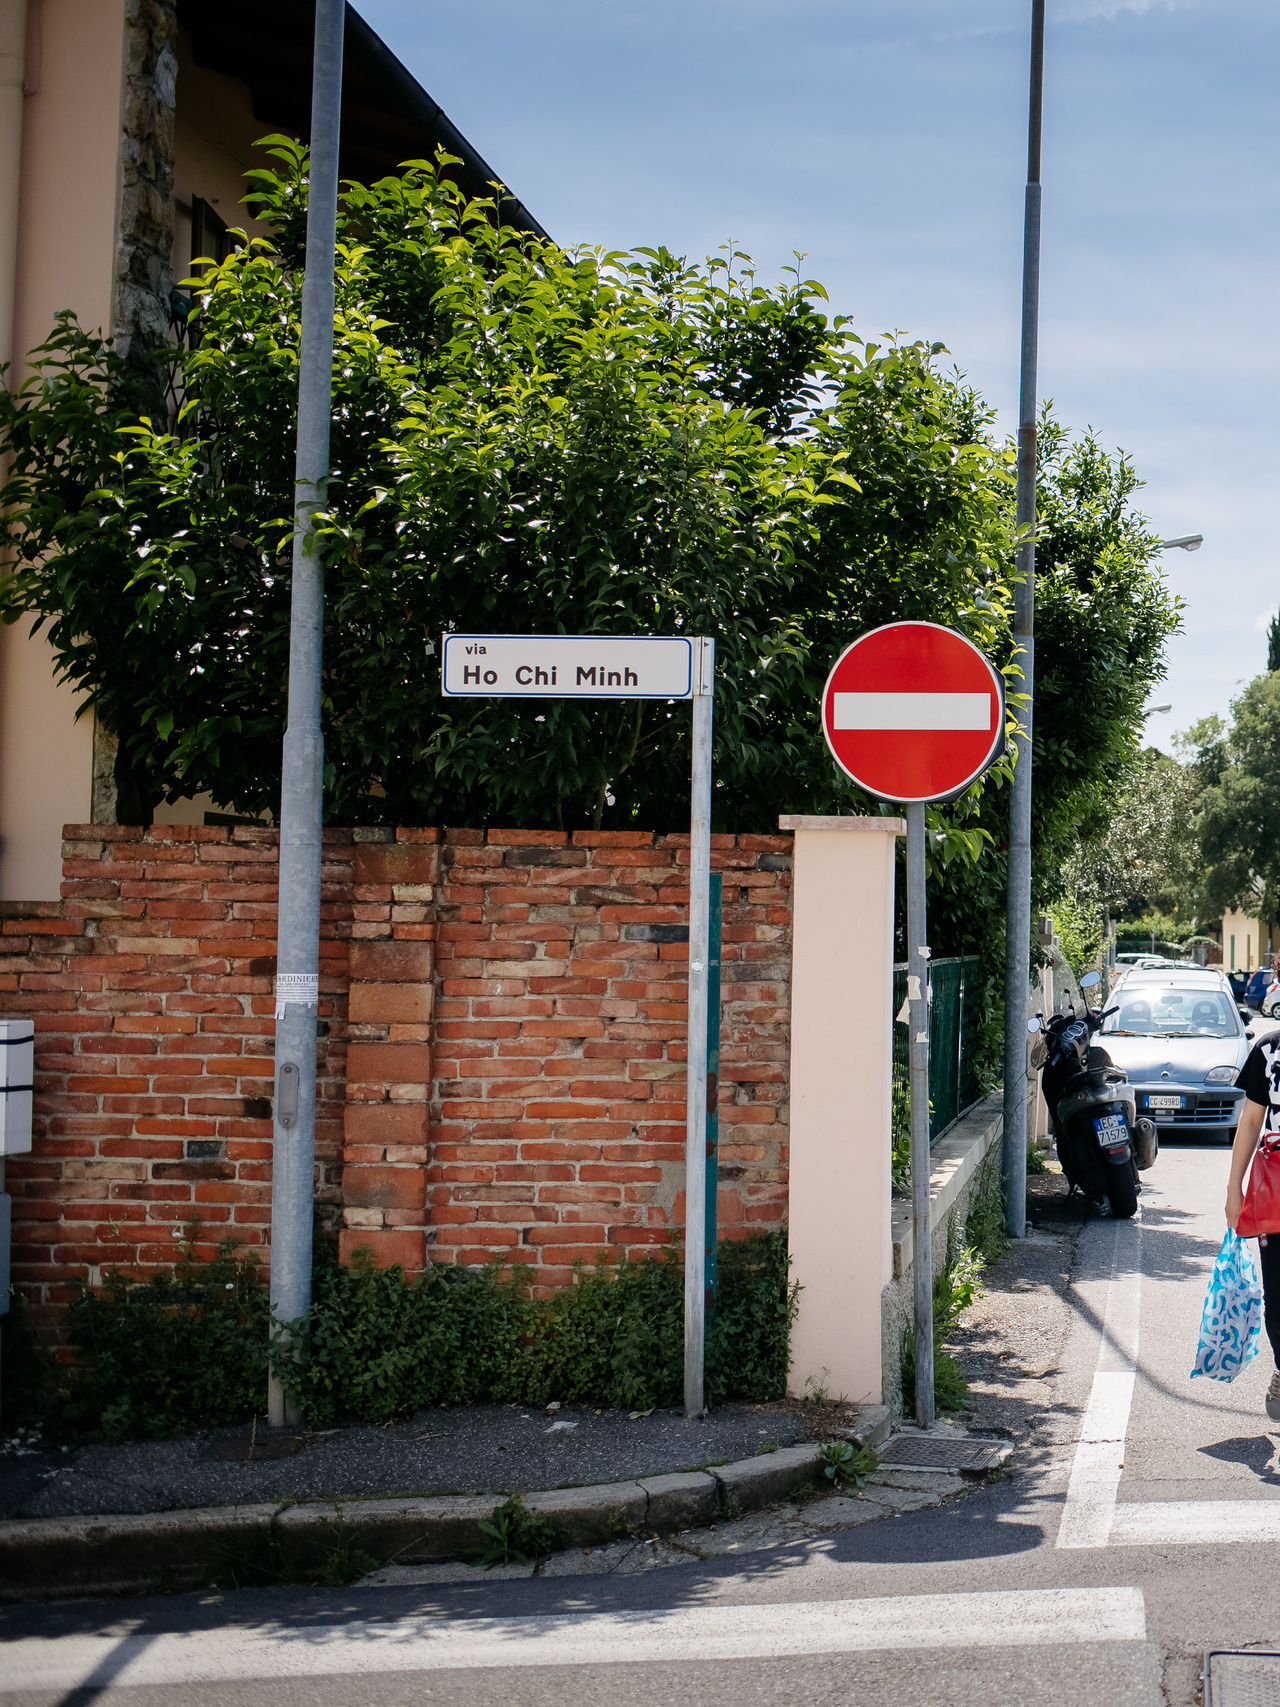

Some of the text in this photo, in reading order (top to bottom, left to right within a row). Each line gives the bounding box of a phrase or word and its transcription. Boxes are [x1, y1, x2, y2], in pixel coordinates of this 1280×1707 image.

[465, 643, 487, 655] via
[463, 665, 638, 687] Ho Chi Minh
[1099, 1127, 1127, 1143] 71579
